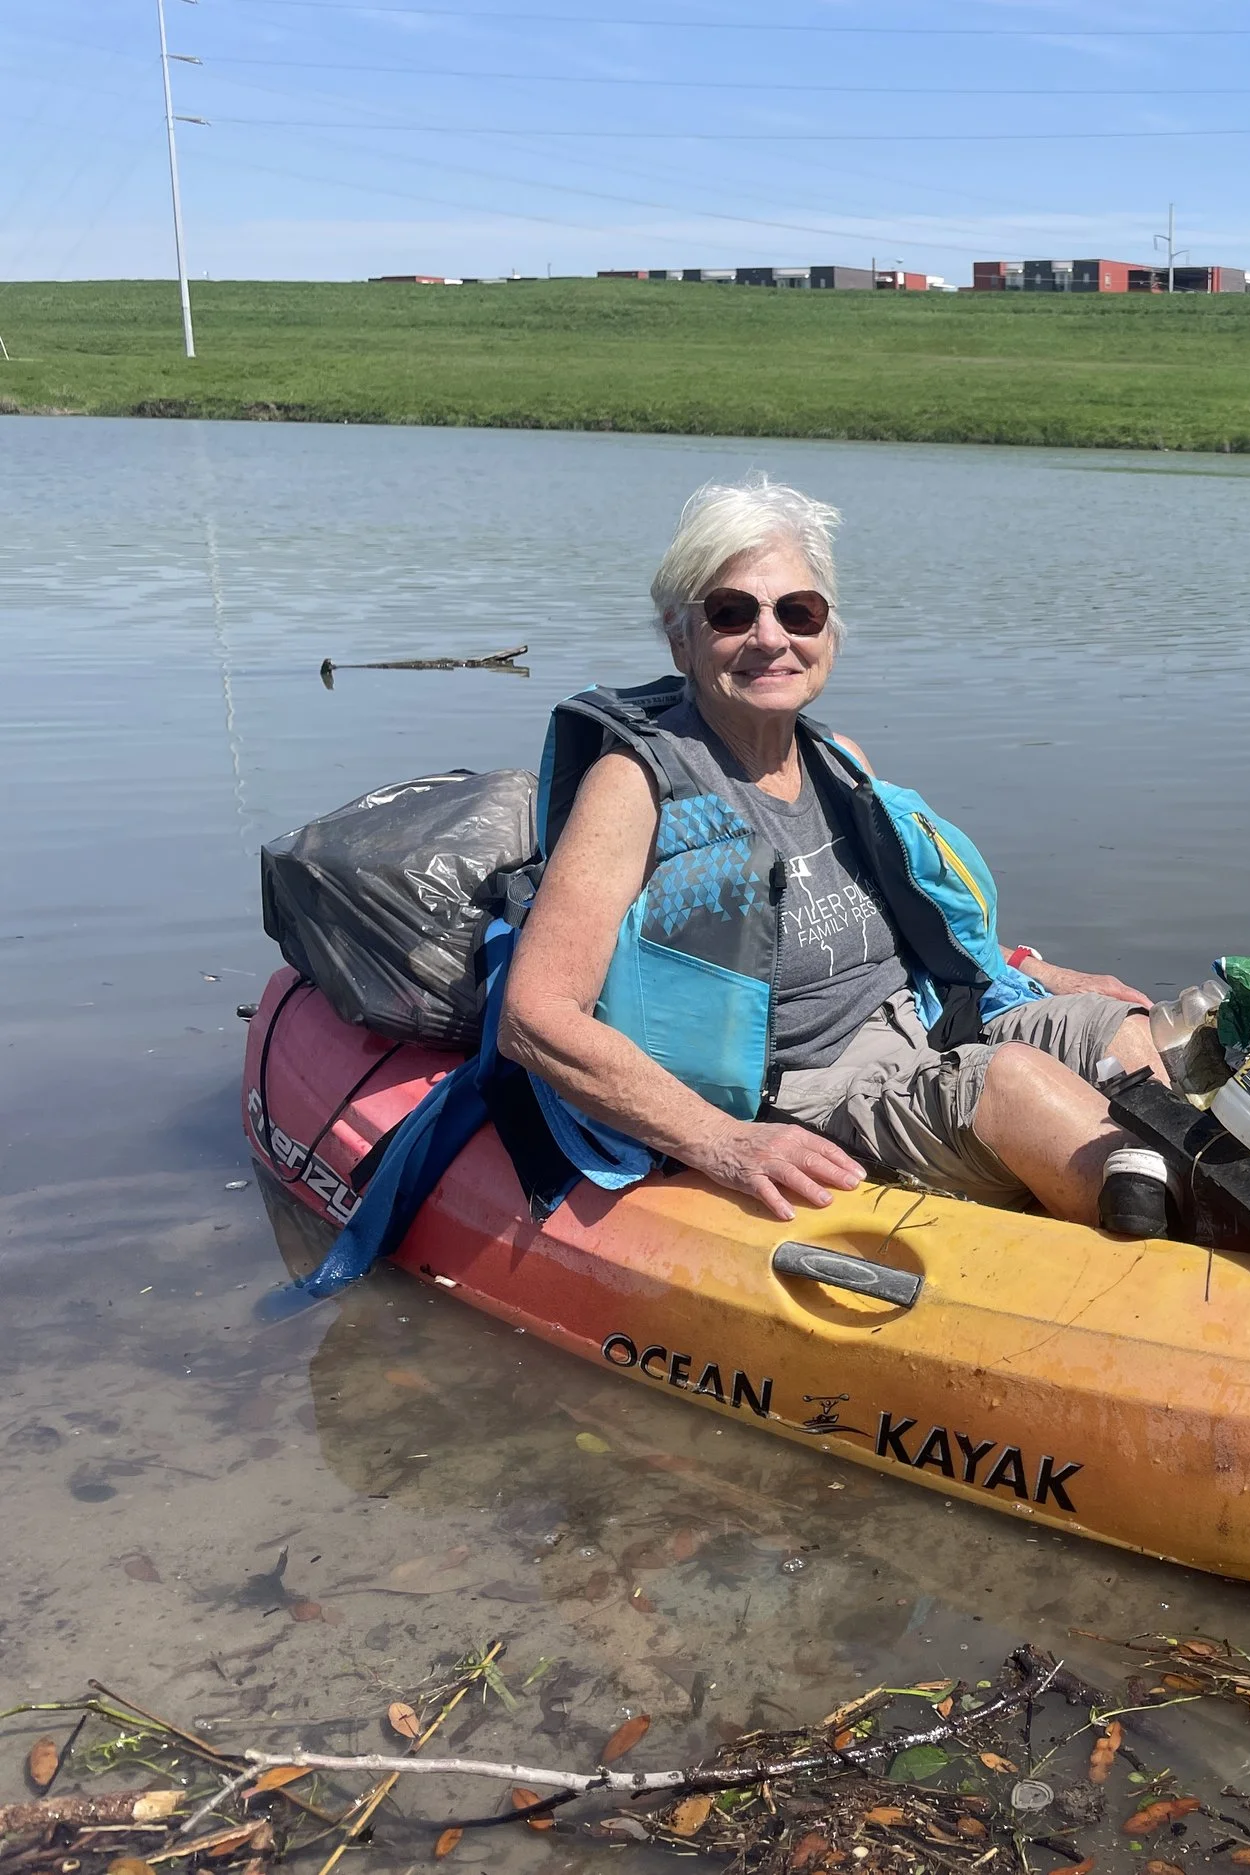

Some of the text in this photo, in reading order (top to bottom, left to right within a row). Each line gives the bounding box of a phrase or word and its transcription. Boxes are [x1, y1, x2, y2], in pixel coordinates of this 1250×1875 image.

[797, 898, 887, 947] FAMILY RESO
[600, 1333, 1085, 1513] OCEAN KAYAK
